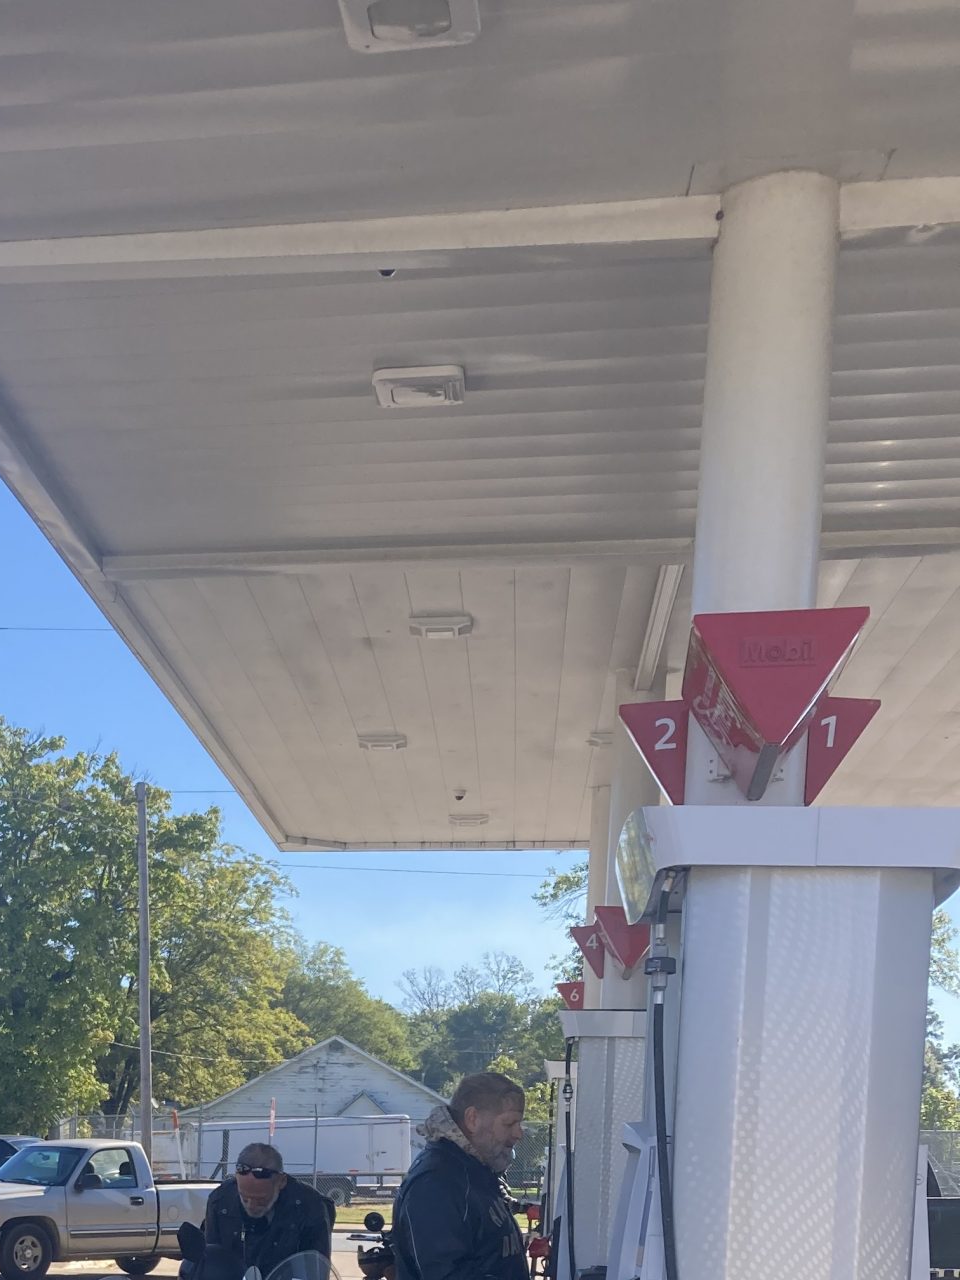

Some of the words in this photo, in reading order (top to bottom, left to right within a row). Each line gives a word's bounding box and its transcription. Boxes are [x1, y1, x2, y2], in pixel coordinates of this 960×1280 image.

[743, 638, 815, 663] Mobil
[655, 717, 676, 750] 2
[820, 715, 837, 748] 1
[585, 933, 599, 950] 4
[570, 989, 579, 1001] 6
